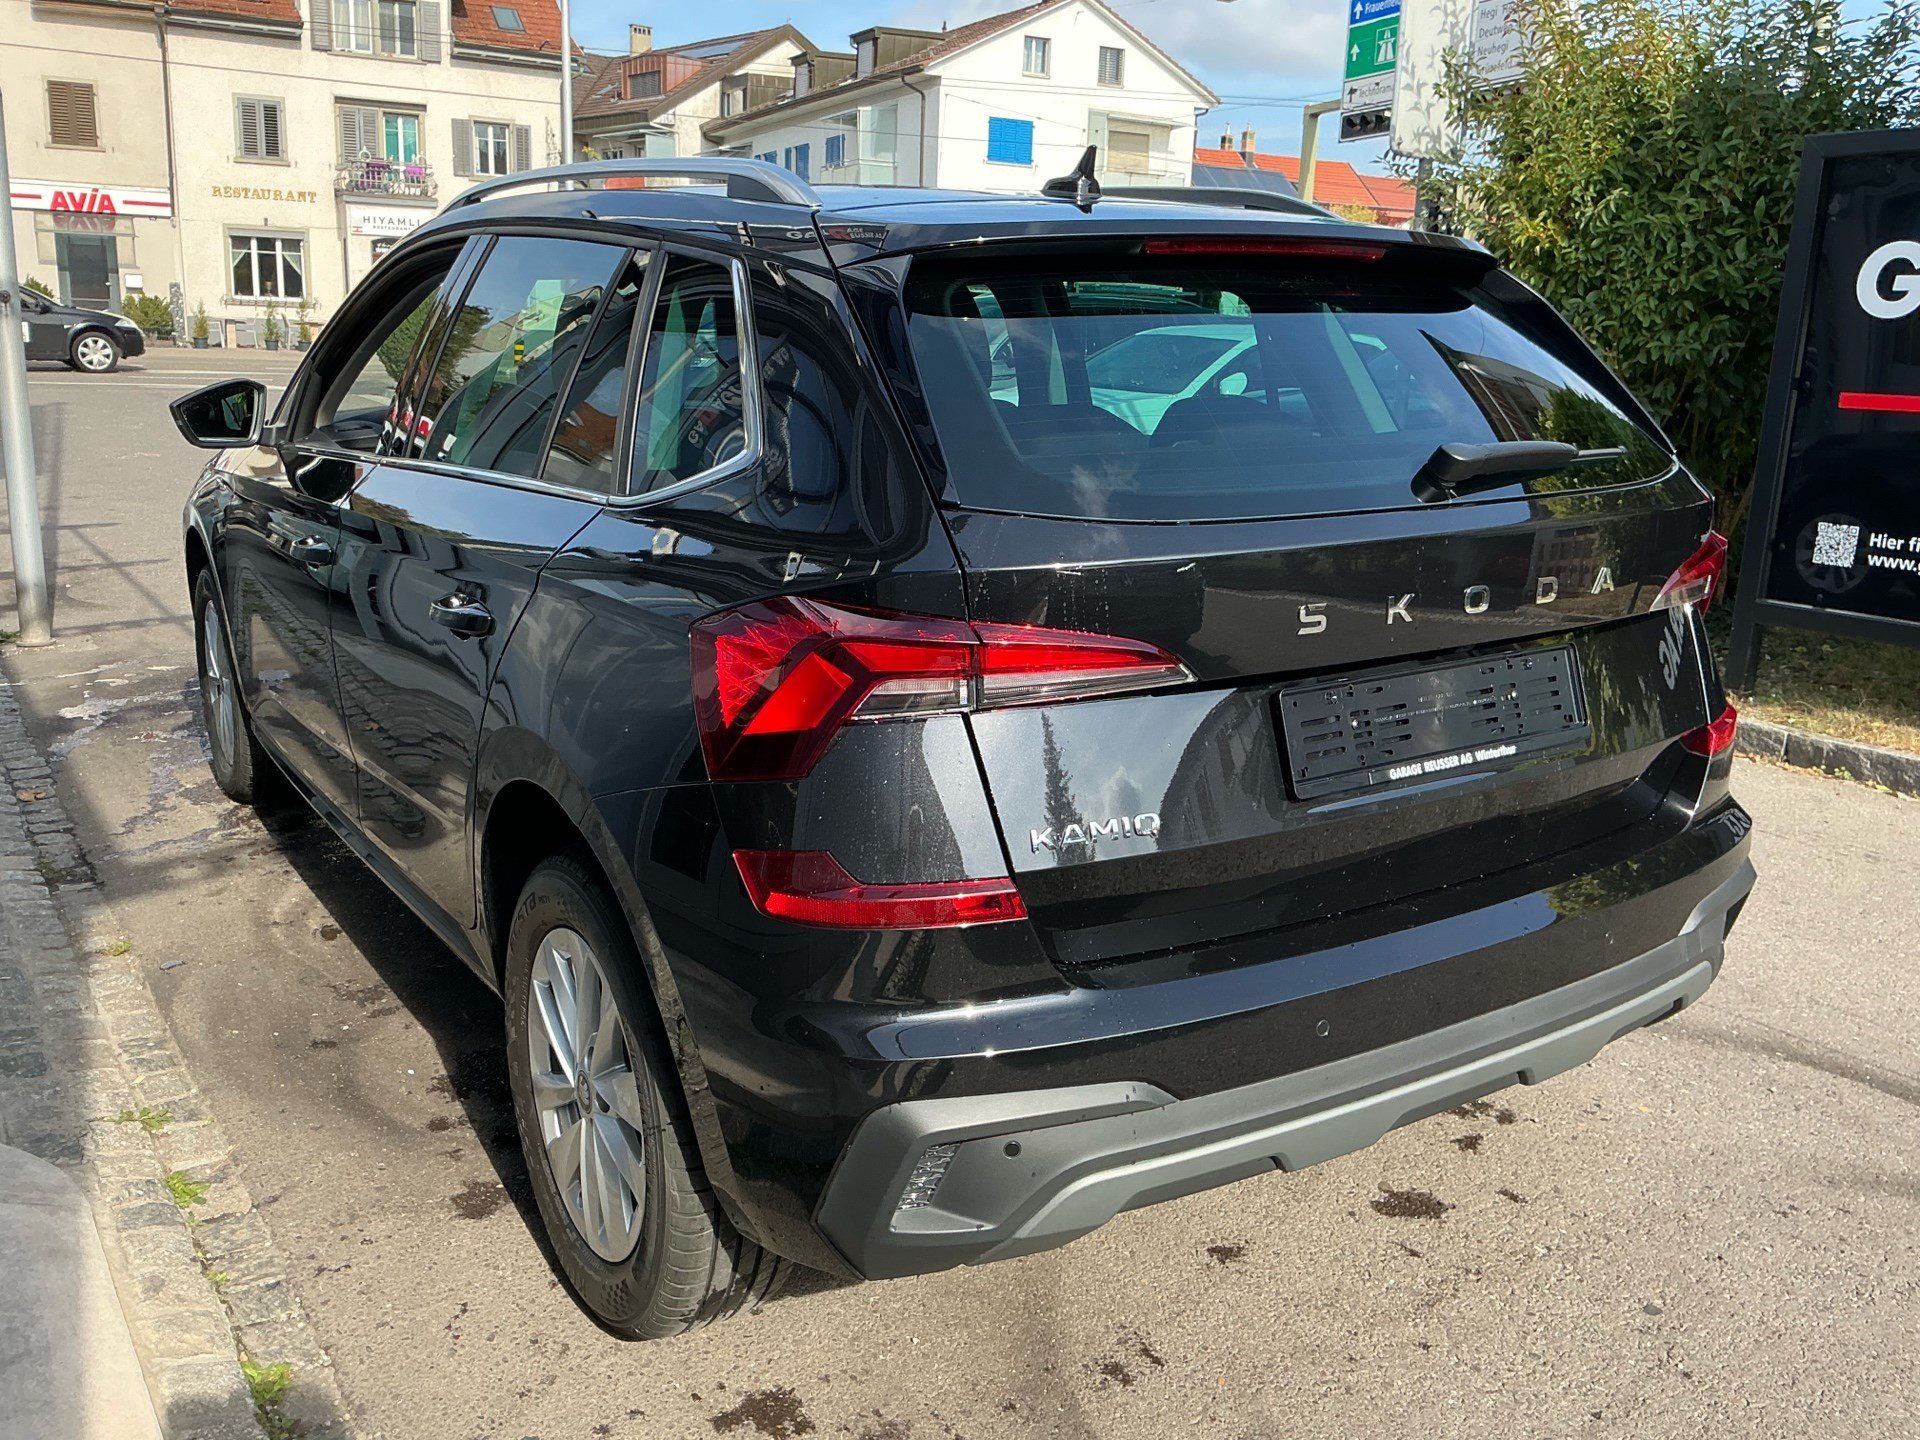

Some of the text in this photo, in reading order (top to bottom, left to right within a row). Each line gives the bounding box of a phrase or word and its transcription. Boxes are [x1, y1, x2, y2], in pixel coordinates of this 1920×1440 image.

[211, 185, 317, 203] RESTAURANT
[1869, 532, 1905, 550] Hier
[1389, 744, 1518, 780] GARAGE REUSSER AG Winterthur
[1029, 812, 1161, 855] KAMIQ
